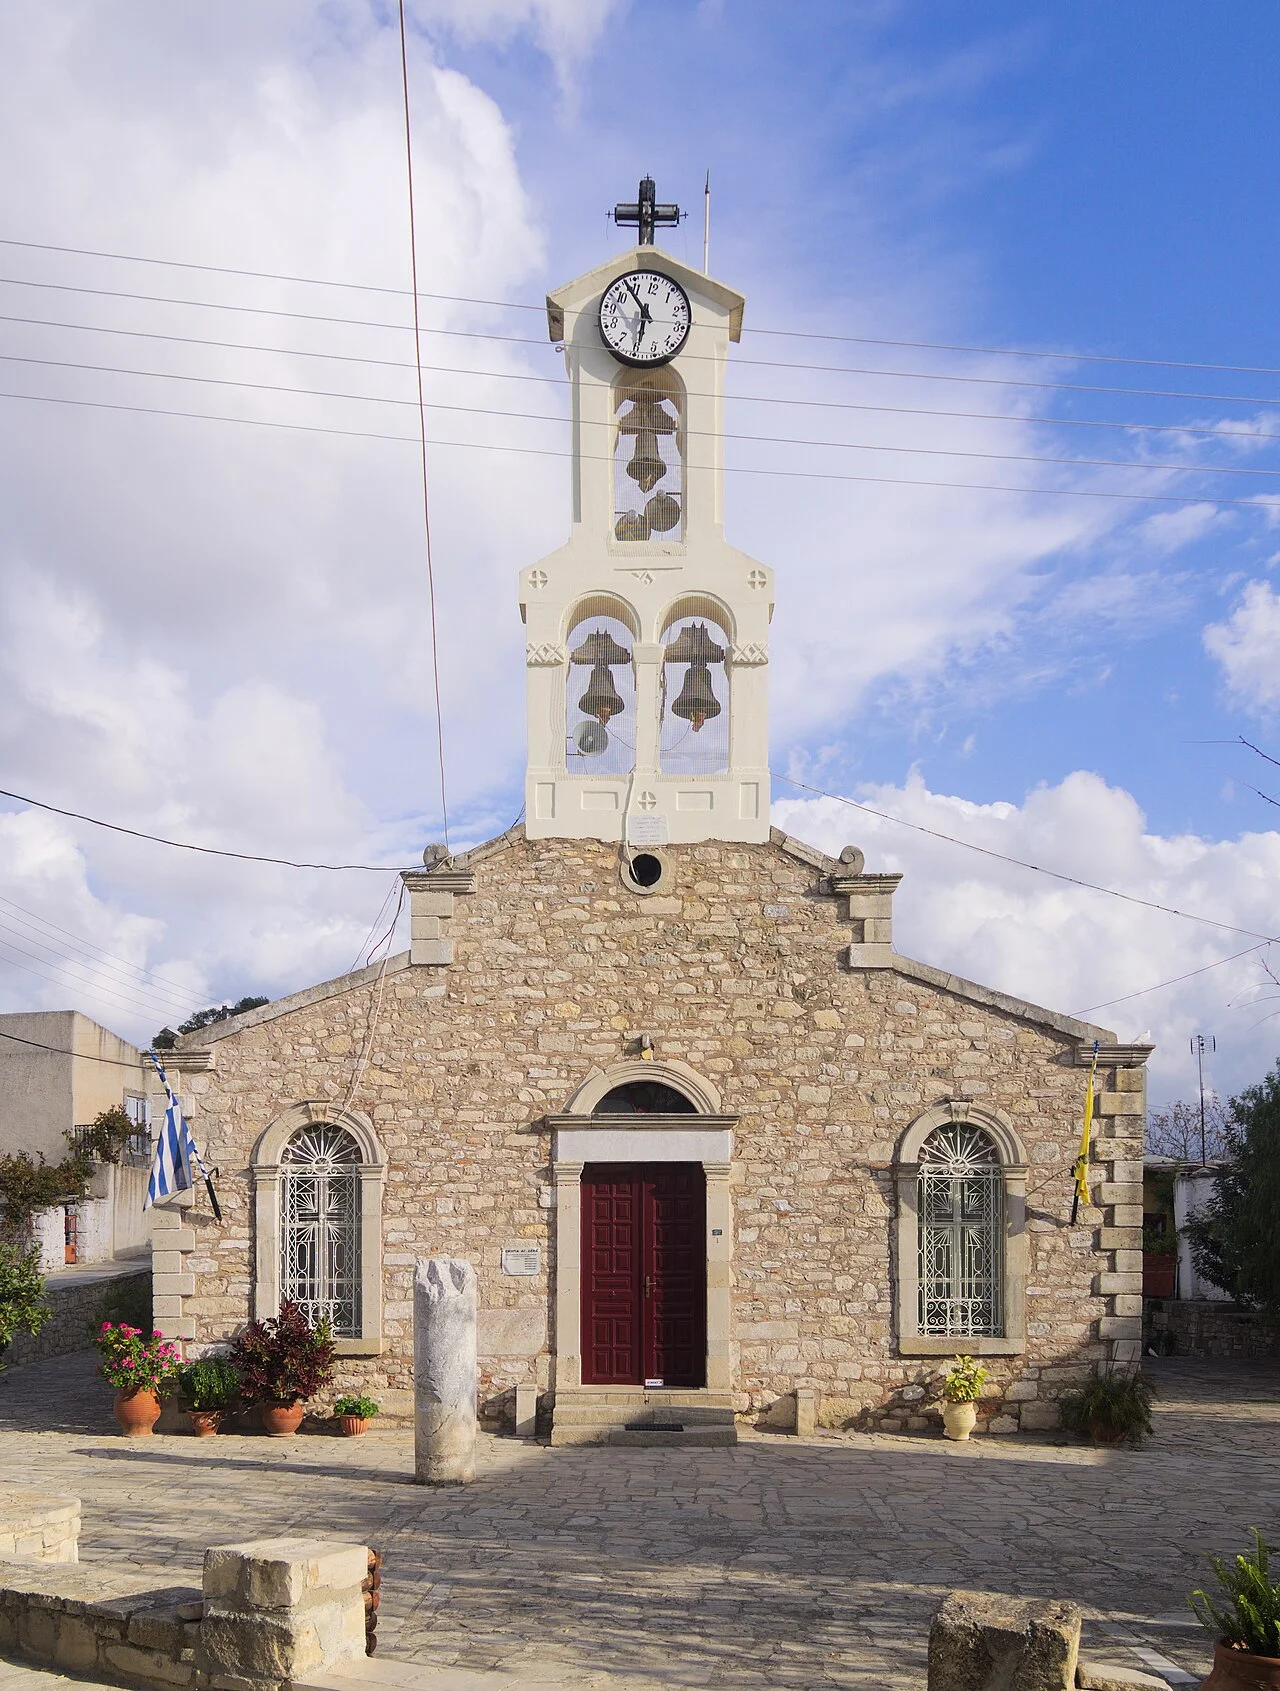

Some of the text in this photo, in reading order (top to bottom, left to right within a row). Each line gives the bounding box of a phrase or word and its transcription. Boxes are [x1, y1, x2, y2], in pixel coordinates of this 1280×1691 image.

[632, 283, 640, 296] 11
[647, 282, 659, 296] 12
[616, 291, 628, 304] 10
[665, 292, 670, 303] 1
[609, 303, 616, 315] 9
[671, 305, 680, 318] 2
[610, 316, 618, 329] 8
[673, 320, 681, 332] 3
[618, 331, 627, 342] 7
[664, 334, 671, 347] 4
[632, 341, 640, 352] 6
[650, 340, 658, 352] 5
